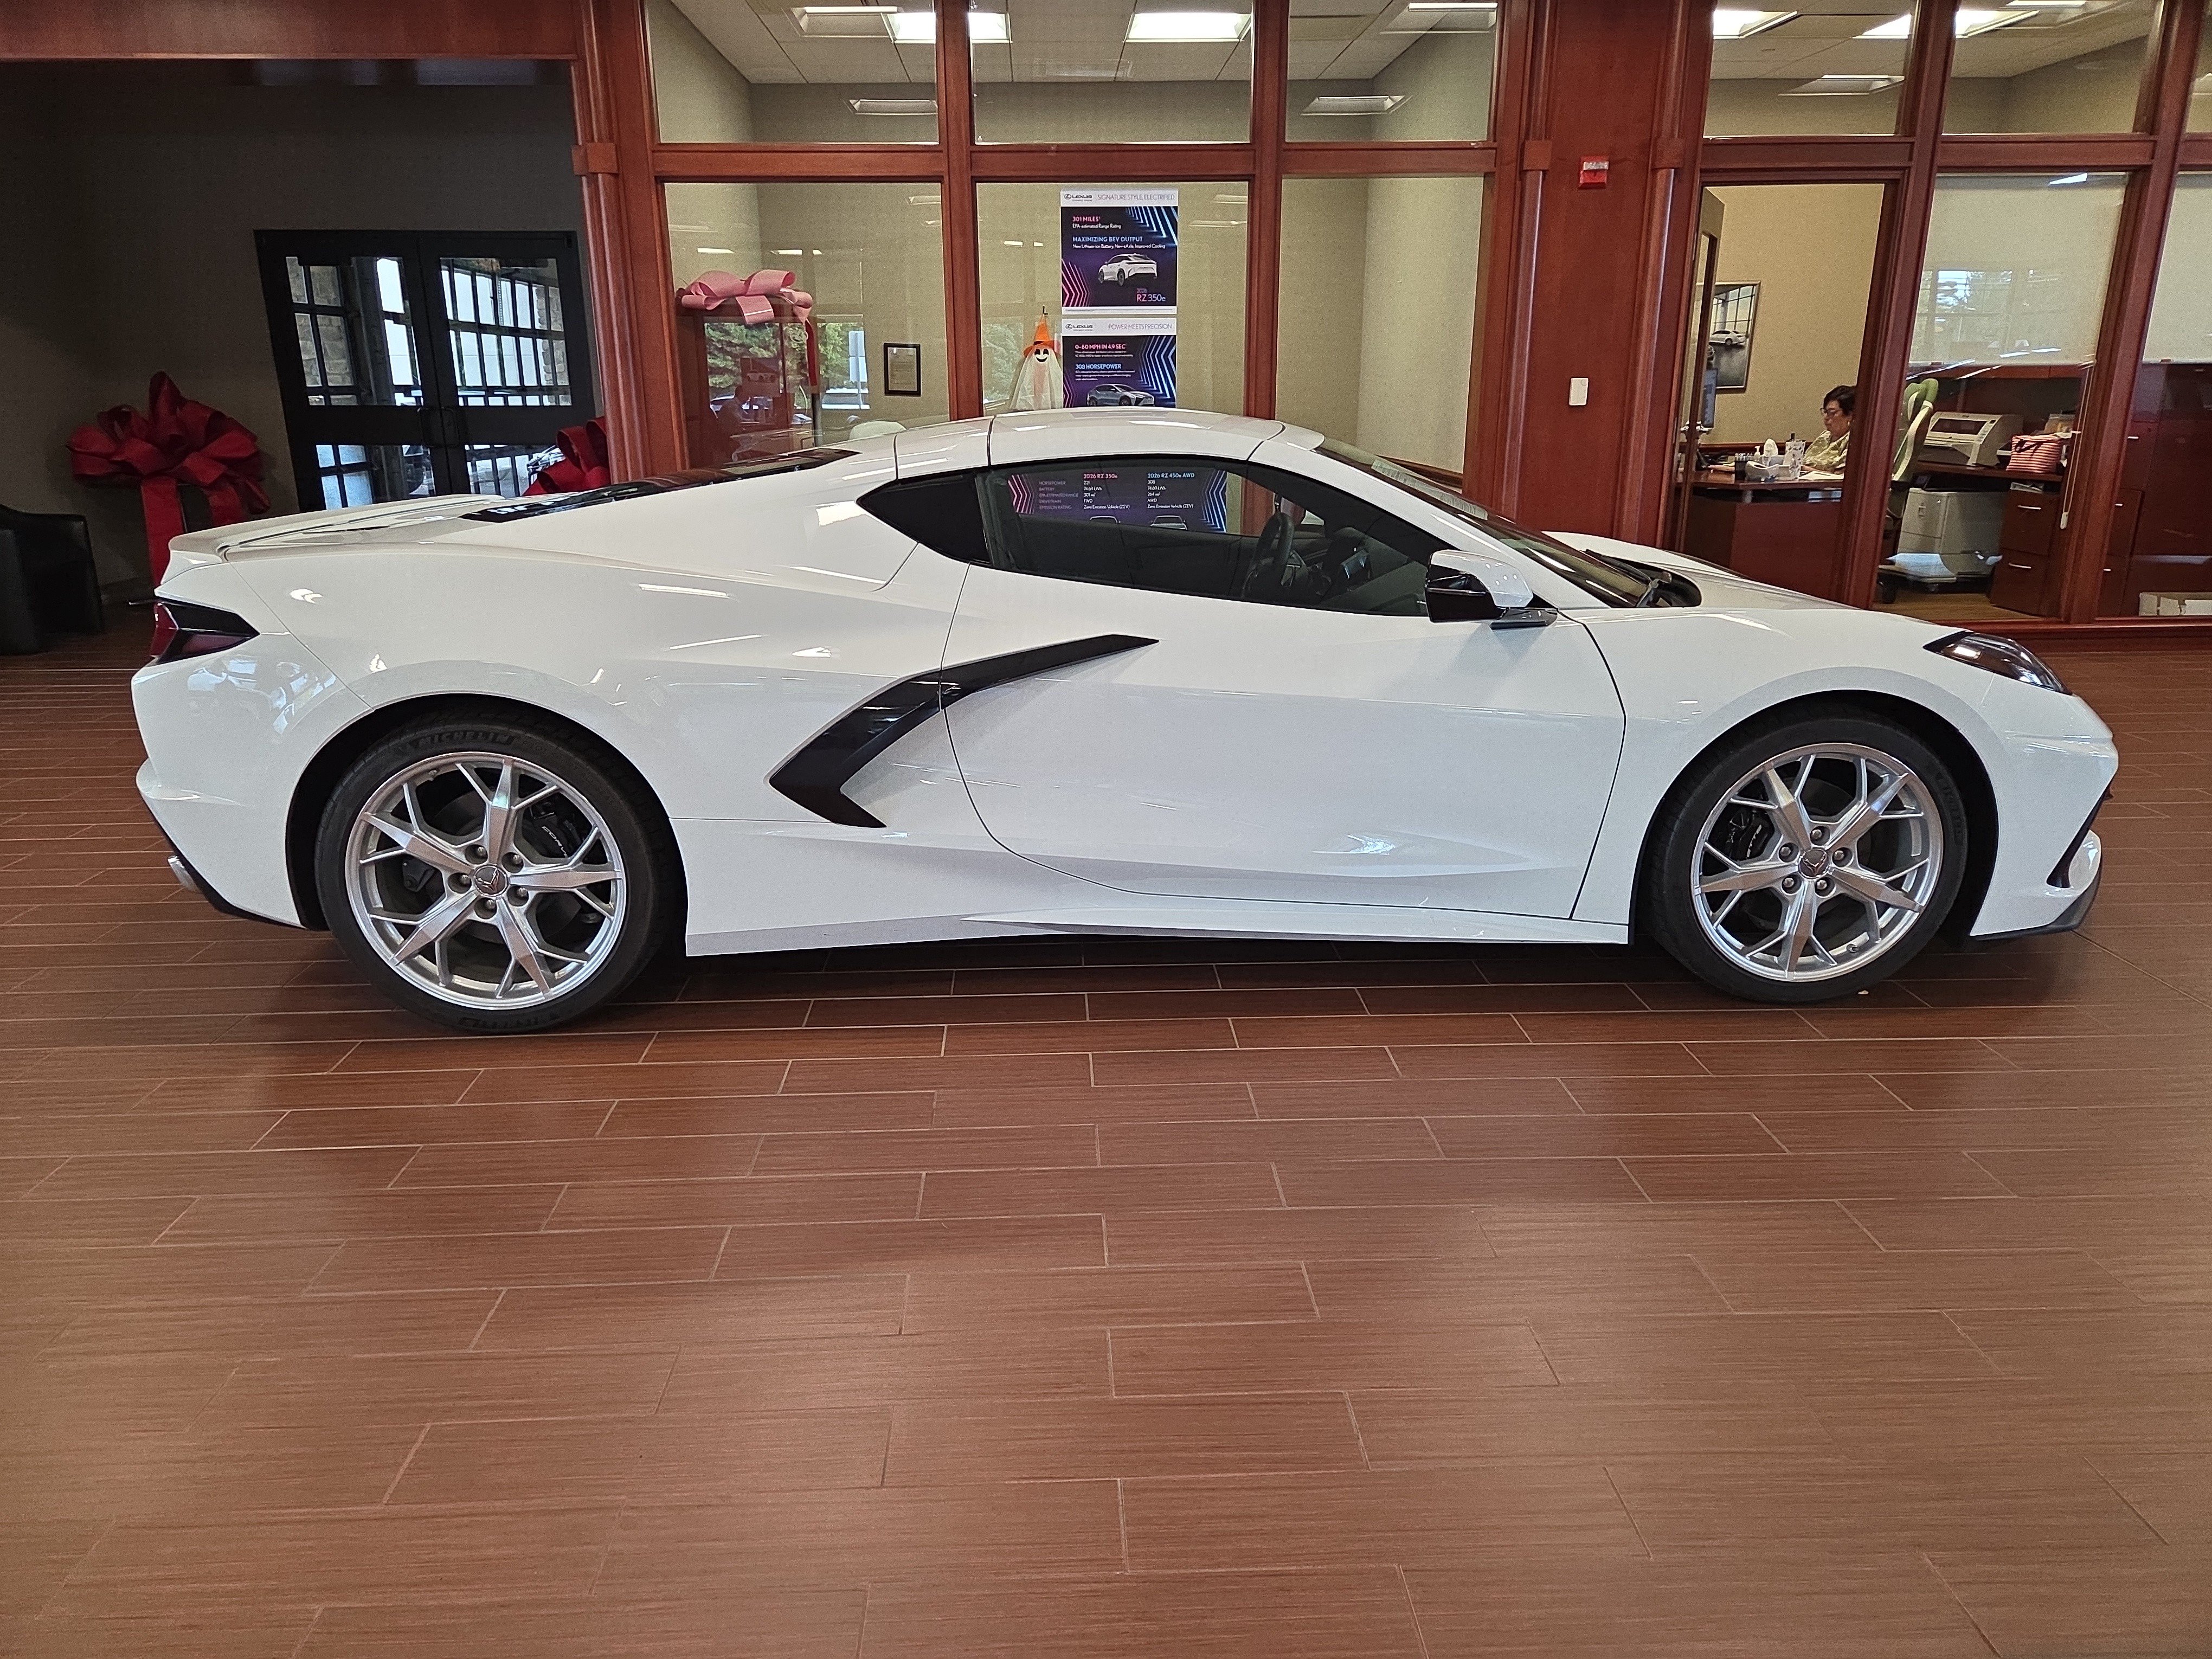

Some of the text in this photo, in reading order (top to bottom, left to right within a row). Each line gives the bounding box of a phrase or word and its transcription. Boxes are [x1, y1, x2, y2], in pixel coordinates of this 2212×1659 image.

[1136, 294, 1166, 302] RZ 350e
[419, 731, 510, 748] MICHELIN
